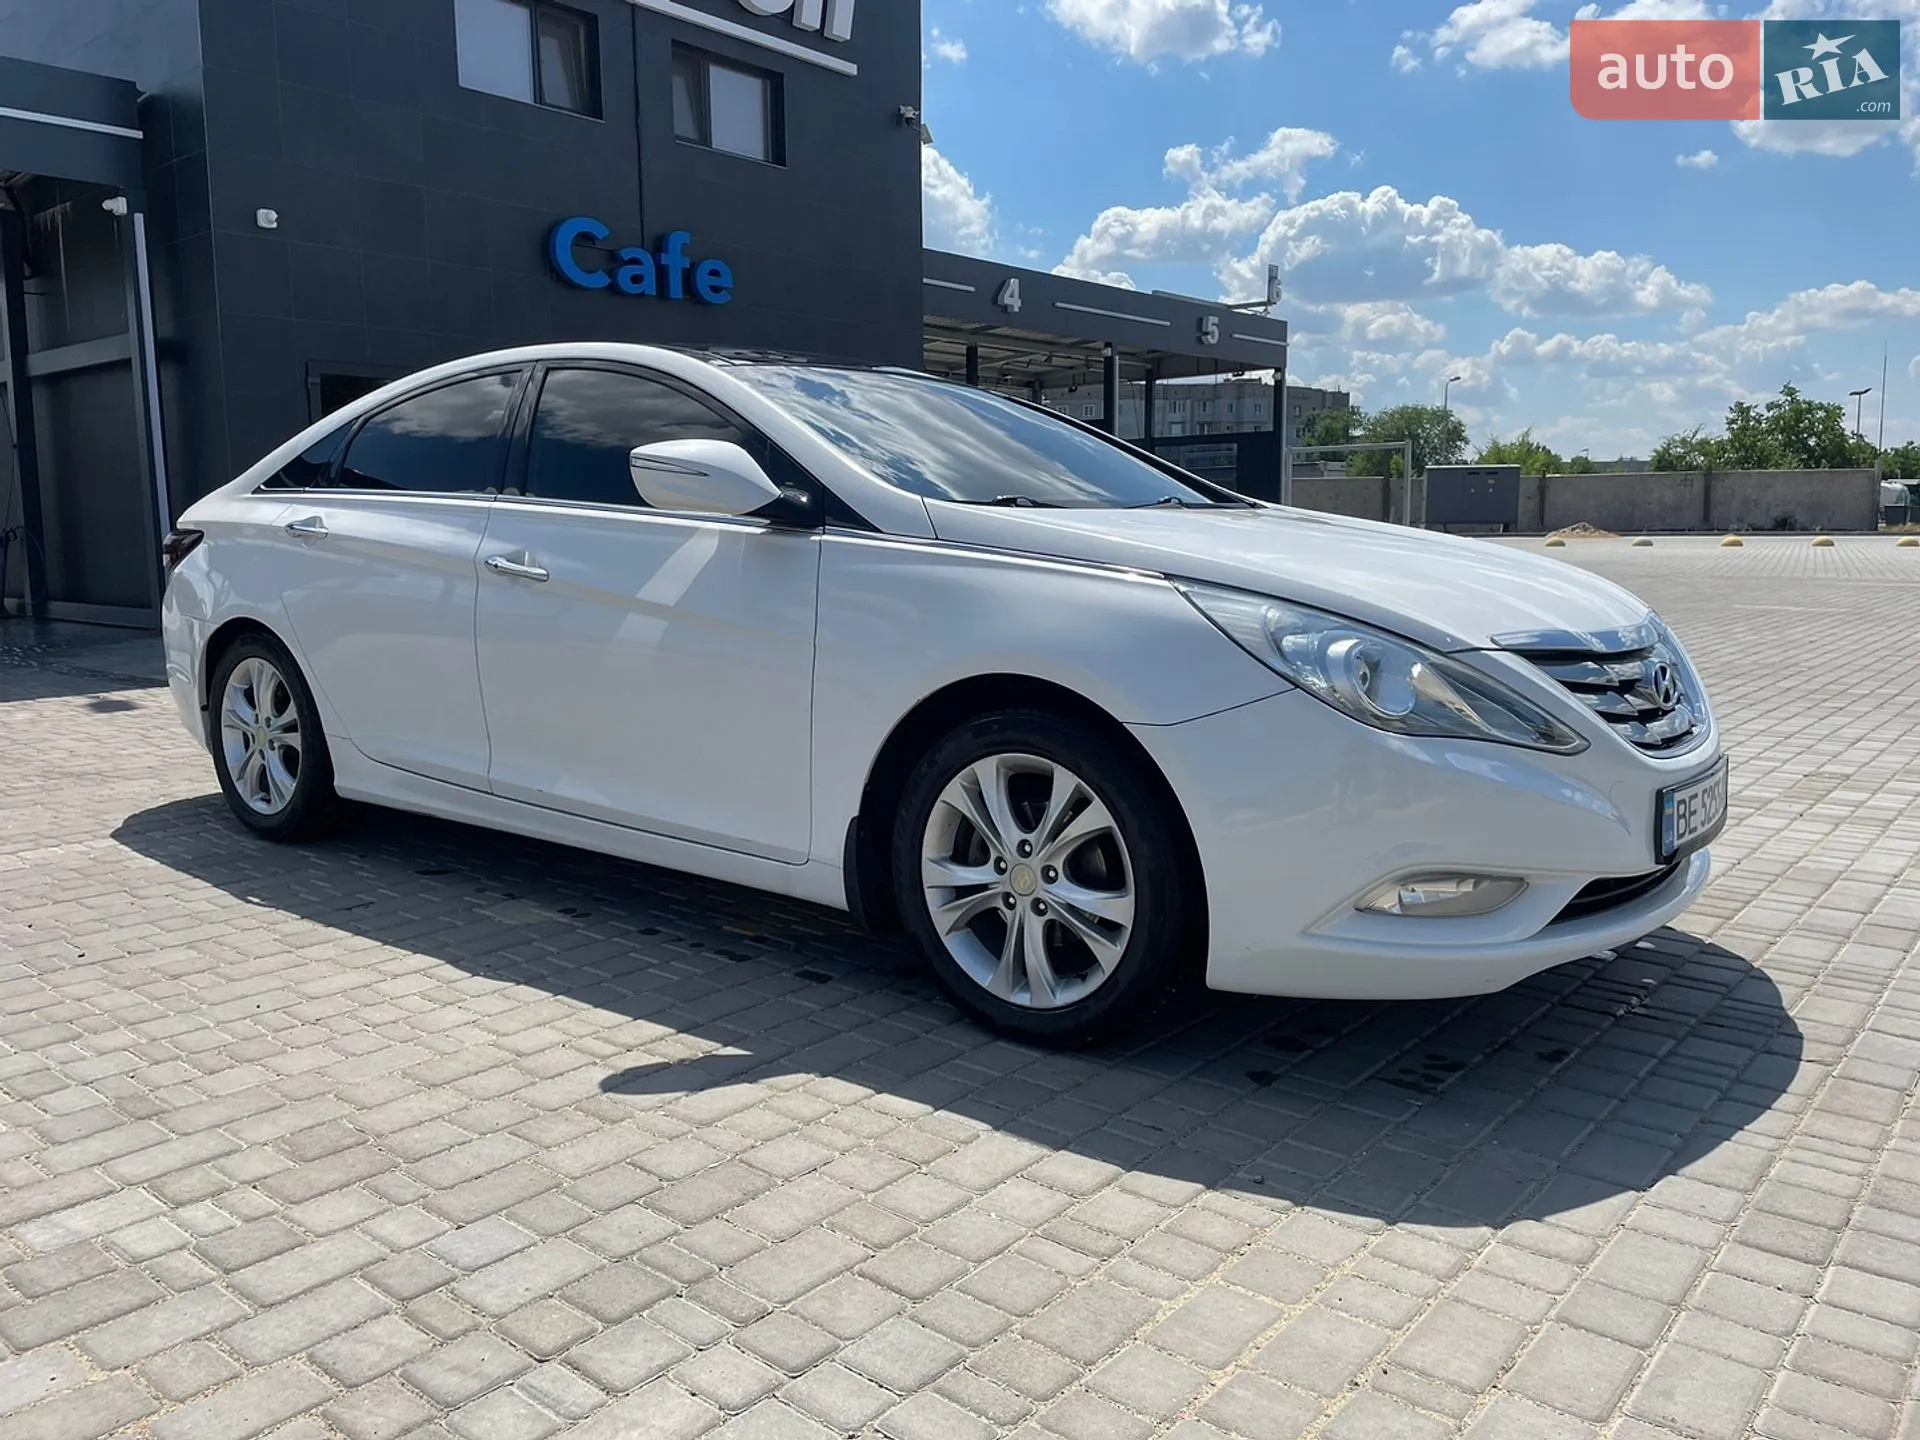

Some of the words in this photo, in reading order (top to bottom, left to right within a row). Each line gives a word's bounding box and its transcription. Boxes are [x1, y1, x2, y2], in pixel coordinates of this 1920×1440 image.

[550, 216, 734, 305] Cafe
[997, 278, 1022, 313] 4
[1200, 316, 1221, 345] 5
[1676, 793, 1699, 841] BE
